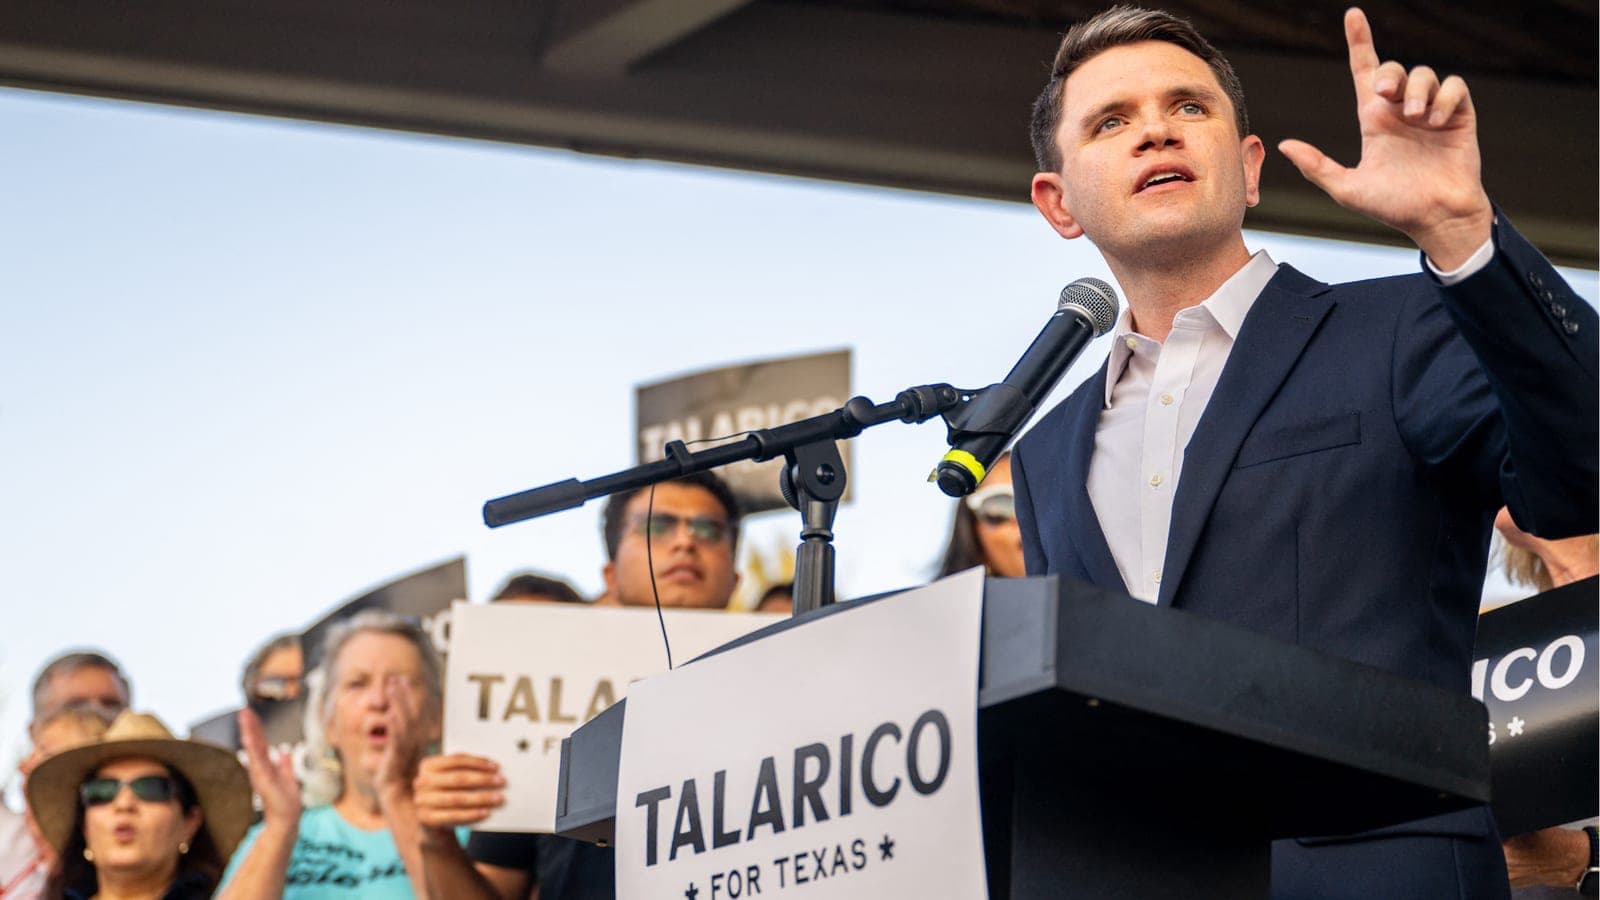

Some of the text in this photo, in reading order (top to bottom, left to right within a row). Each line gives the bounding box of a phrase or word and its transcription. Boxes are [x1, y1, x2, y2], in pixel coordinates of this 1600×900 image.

[636, 709, 951, 866] TALARICO
[711, 838, 867, 900] FOR TEXAS
